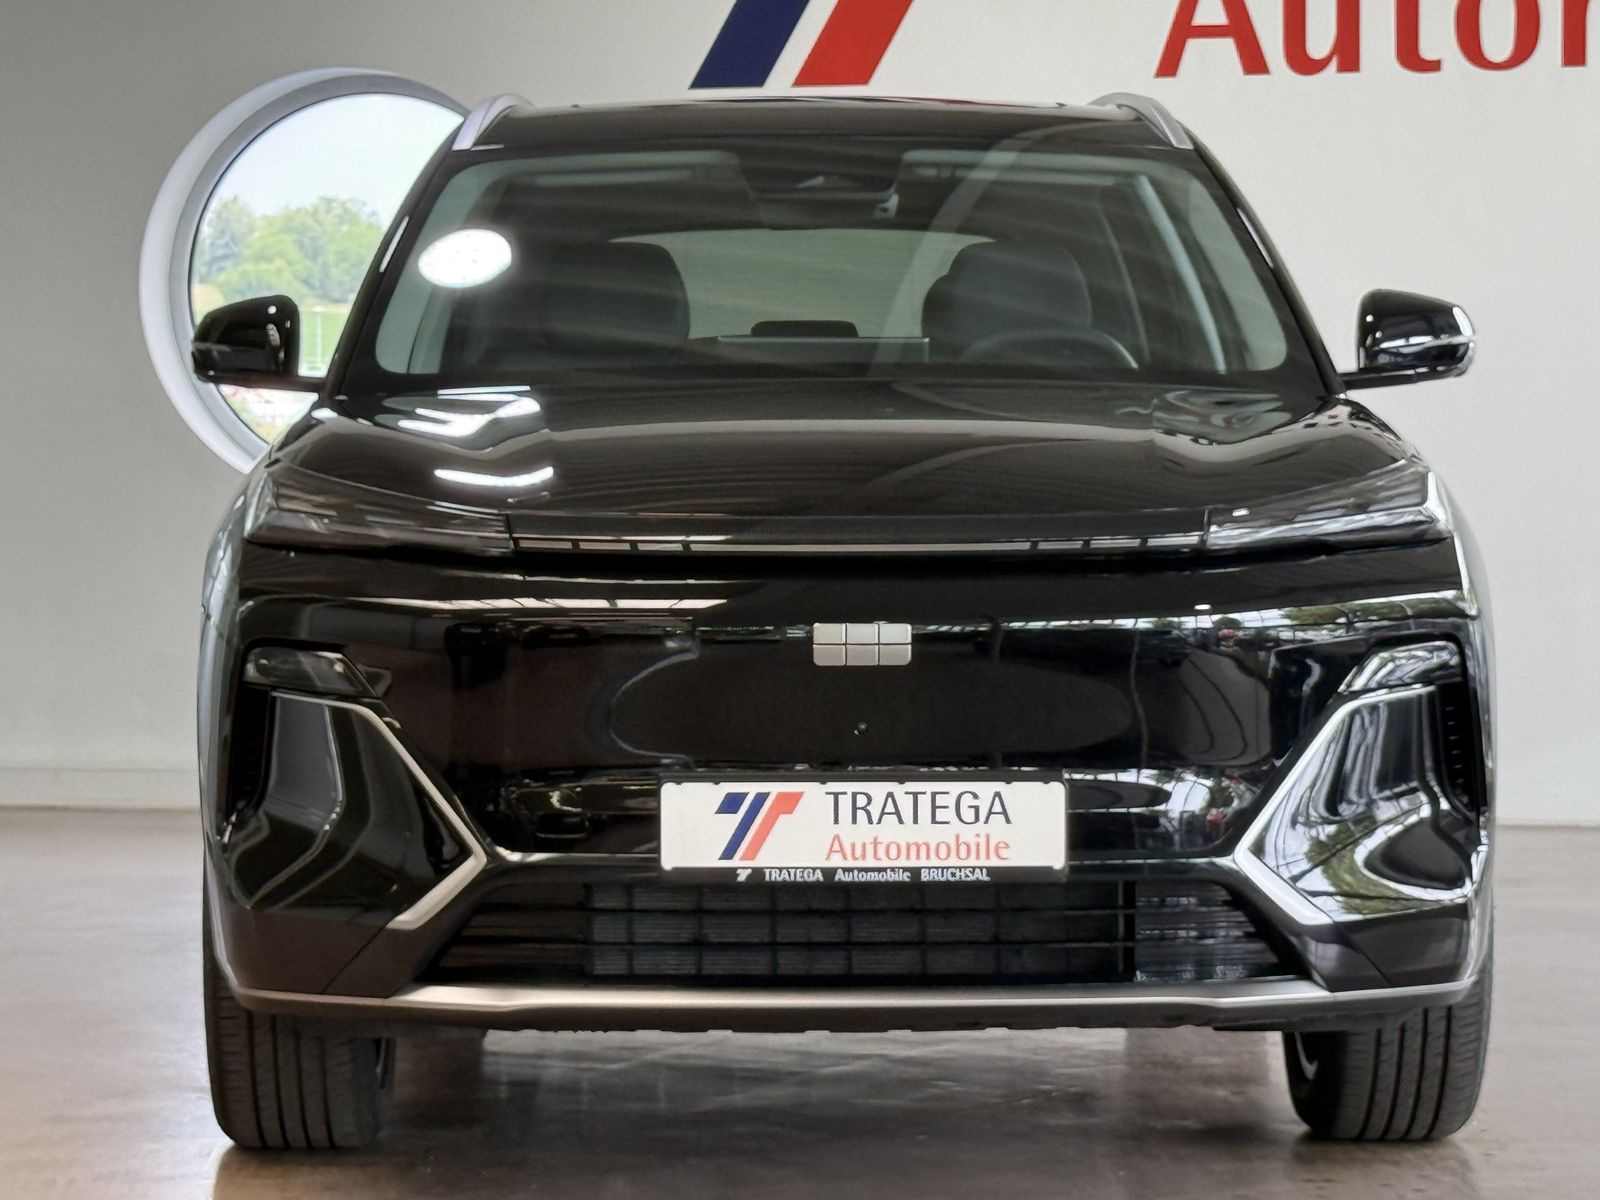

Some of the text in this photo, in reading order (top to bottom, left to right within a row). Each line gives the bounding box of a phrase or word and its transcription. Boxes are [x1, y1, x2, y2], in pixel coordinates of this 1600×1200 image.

[1154, 0, 1600, 78] Auto
[825, 791, 1012, 825] TRATEGA
[825, 833, 1011, 861] Automobile
[764, 867, 990, 882] TRATEGA Automobile BRUCHSAL
